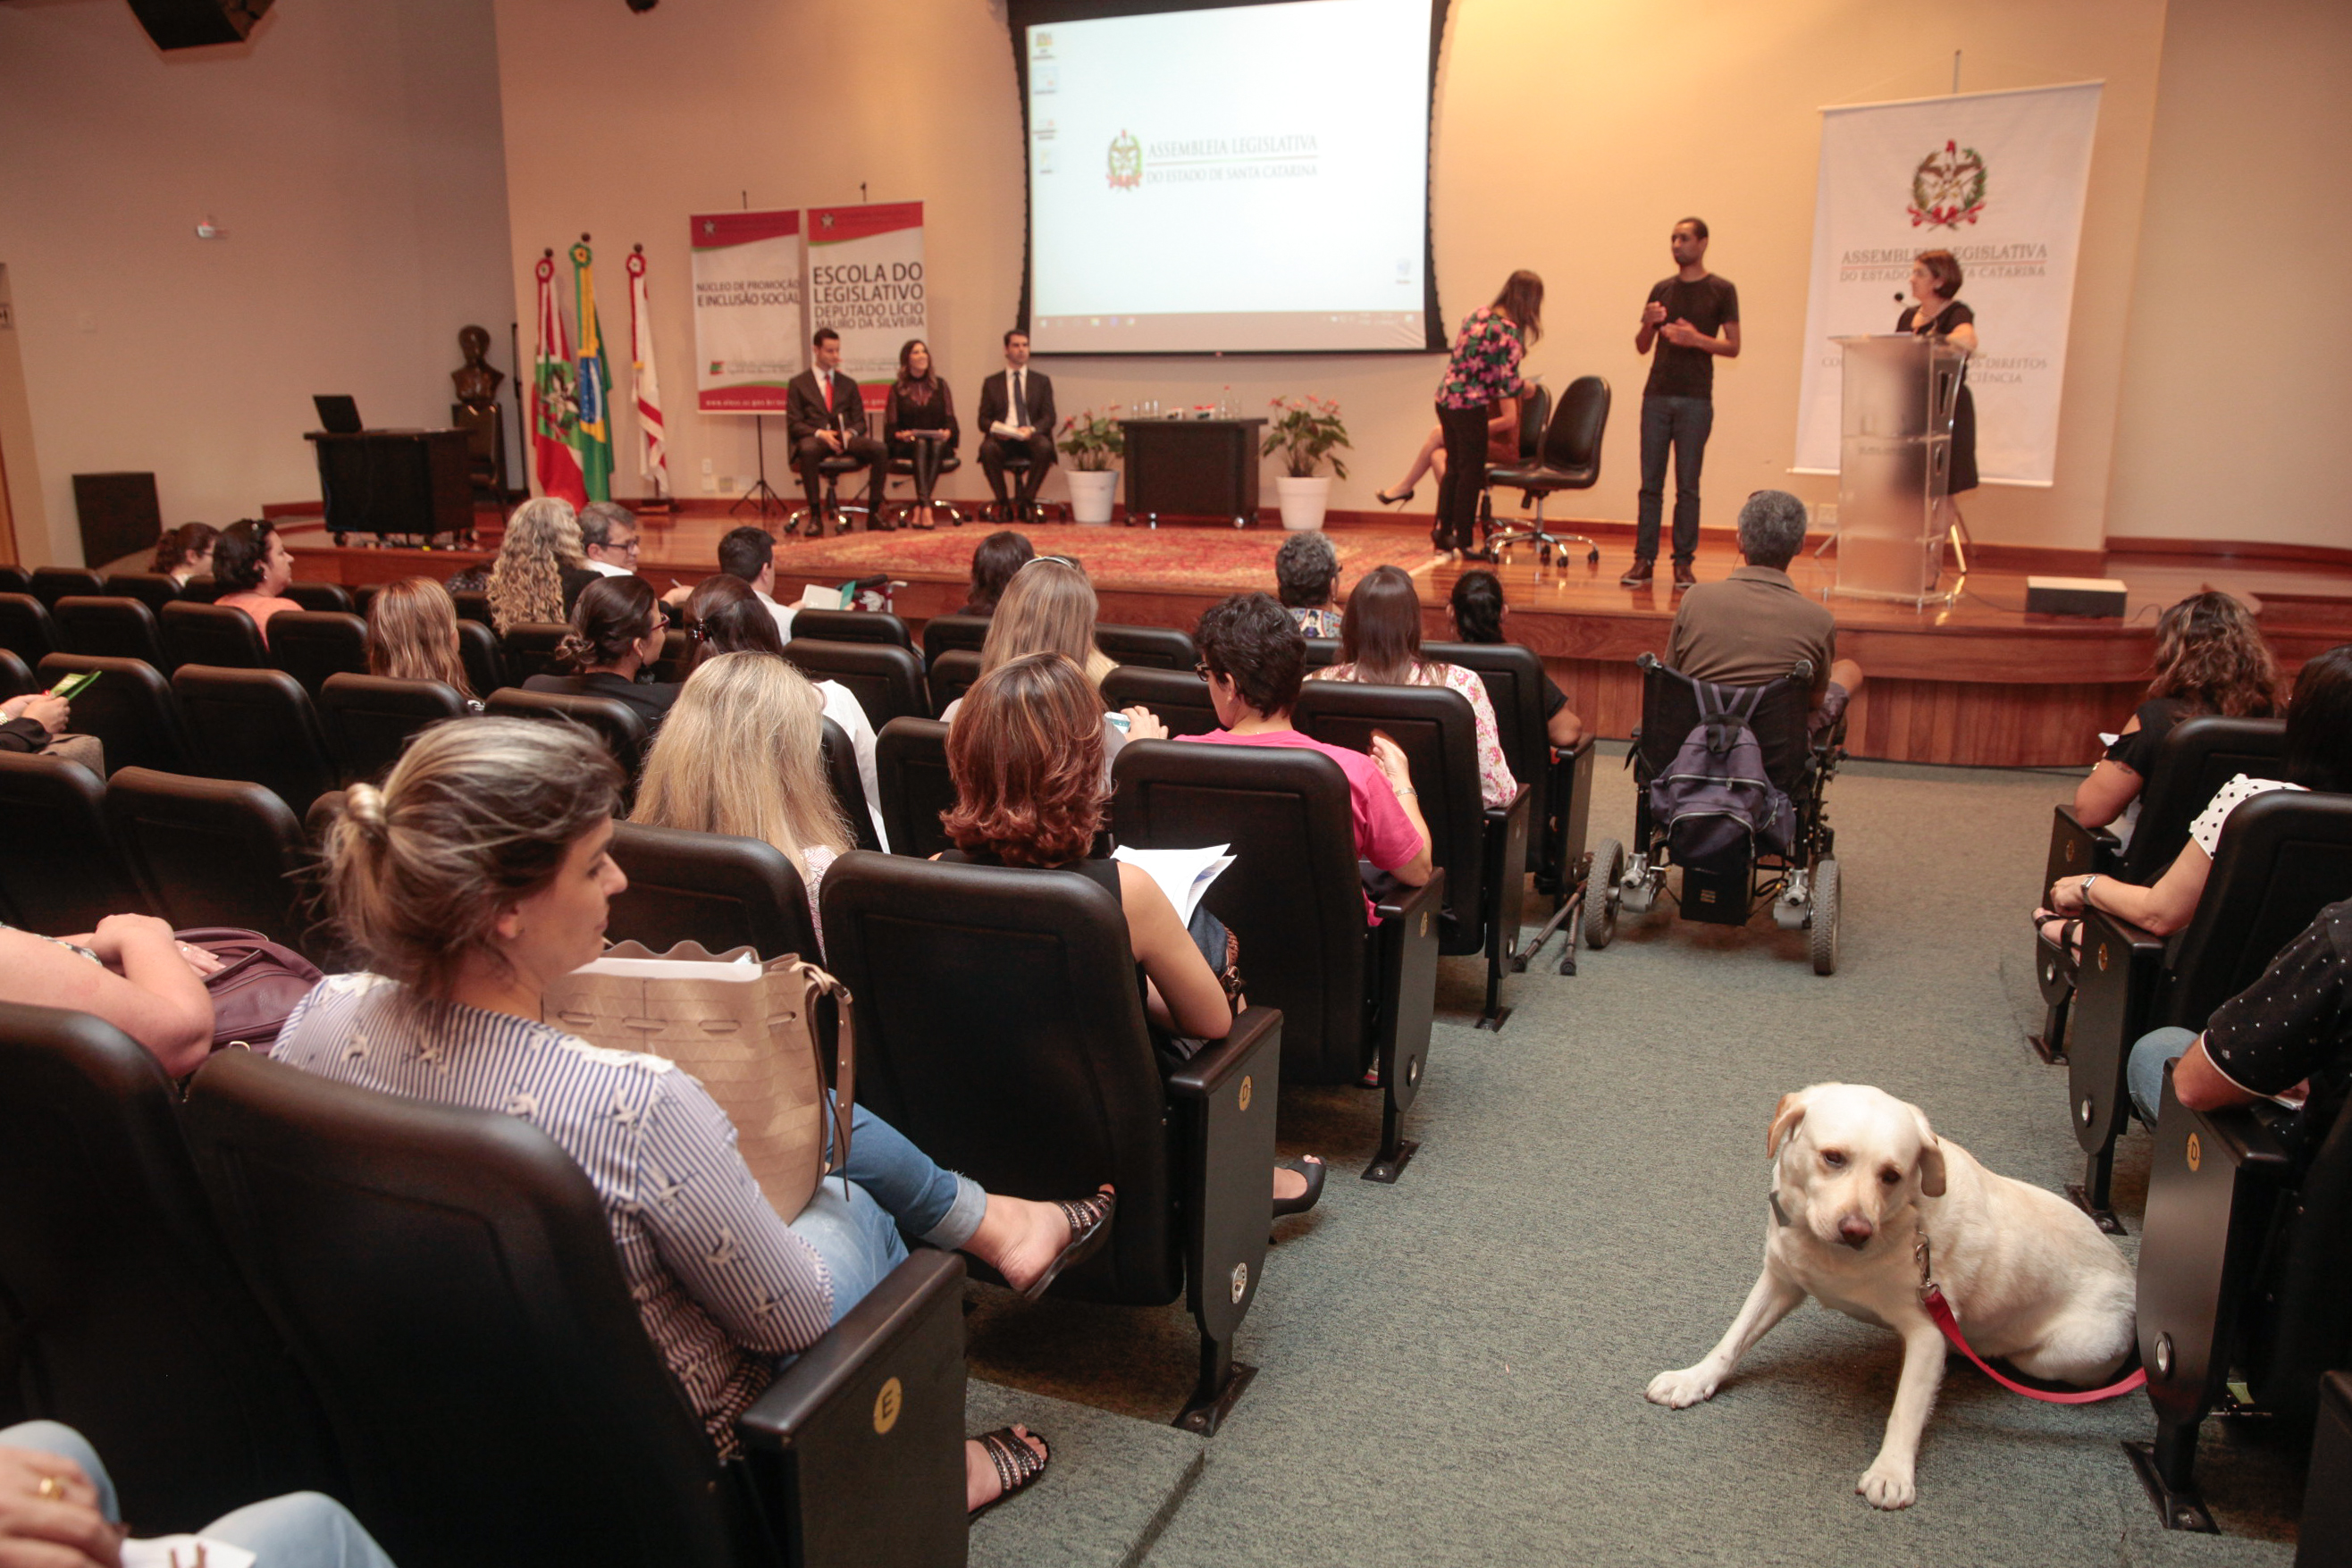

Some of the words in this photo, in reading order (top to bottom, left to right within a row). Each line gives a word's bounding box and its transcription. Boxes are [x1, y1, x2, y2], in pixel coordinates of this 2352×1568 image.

[1148, 138, 1228, 158] ASSEMBLEIA
[1231, 134, 1318, 154] LEGISLATIVA
[1147, 169, 1163, 184] DO
[1166, 167, 1207, 182] ESTADO
[1209, 167, 1224, 180] DE
[1226, 165, 1261, 180] SANTA
[1263, 164, 1318, 178] CATARINA
[1952, 243, 2047, 262] EGISLATIVA
[813, 264, 886, 285] ESCOLA
[892, 261, 923, 281] DO
[698, 294, 704, 307] E
[760, 291, 801, 306] SOCIAL
[813, 282, 924, 304] LEGISLATIVO
[814, 303, 886, 318] DEPUTADO
[881, 1388, 894, 1421] E
